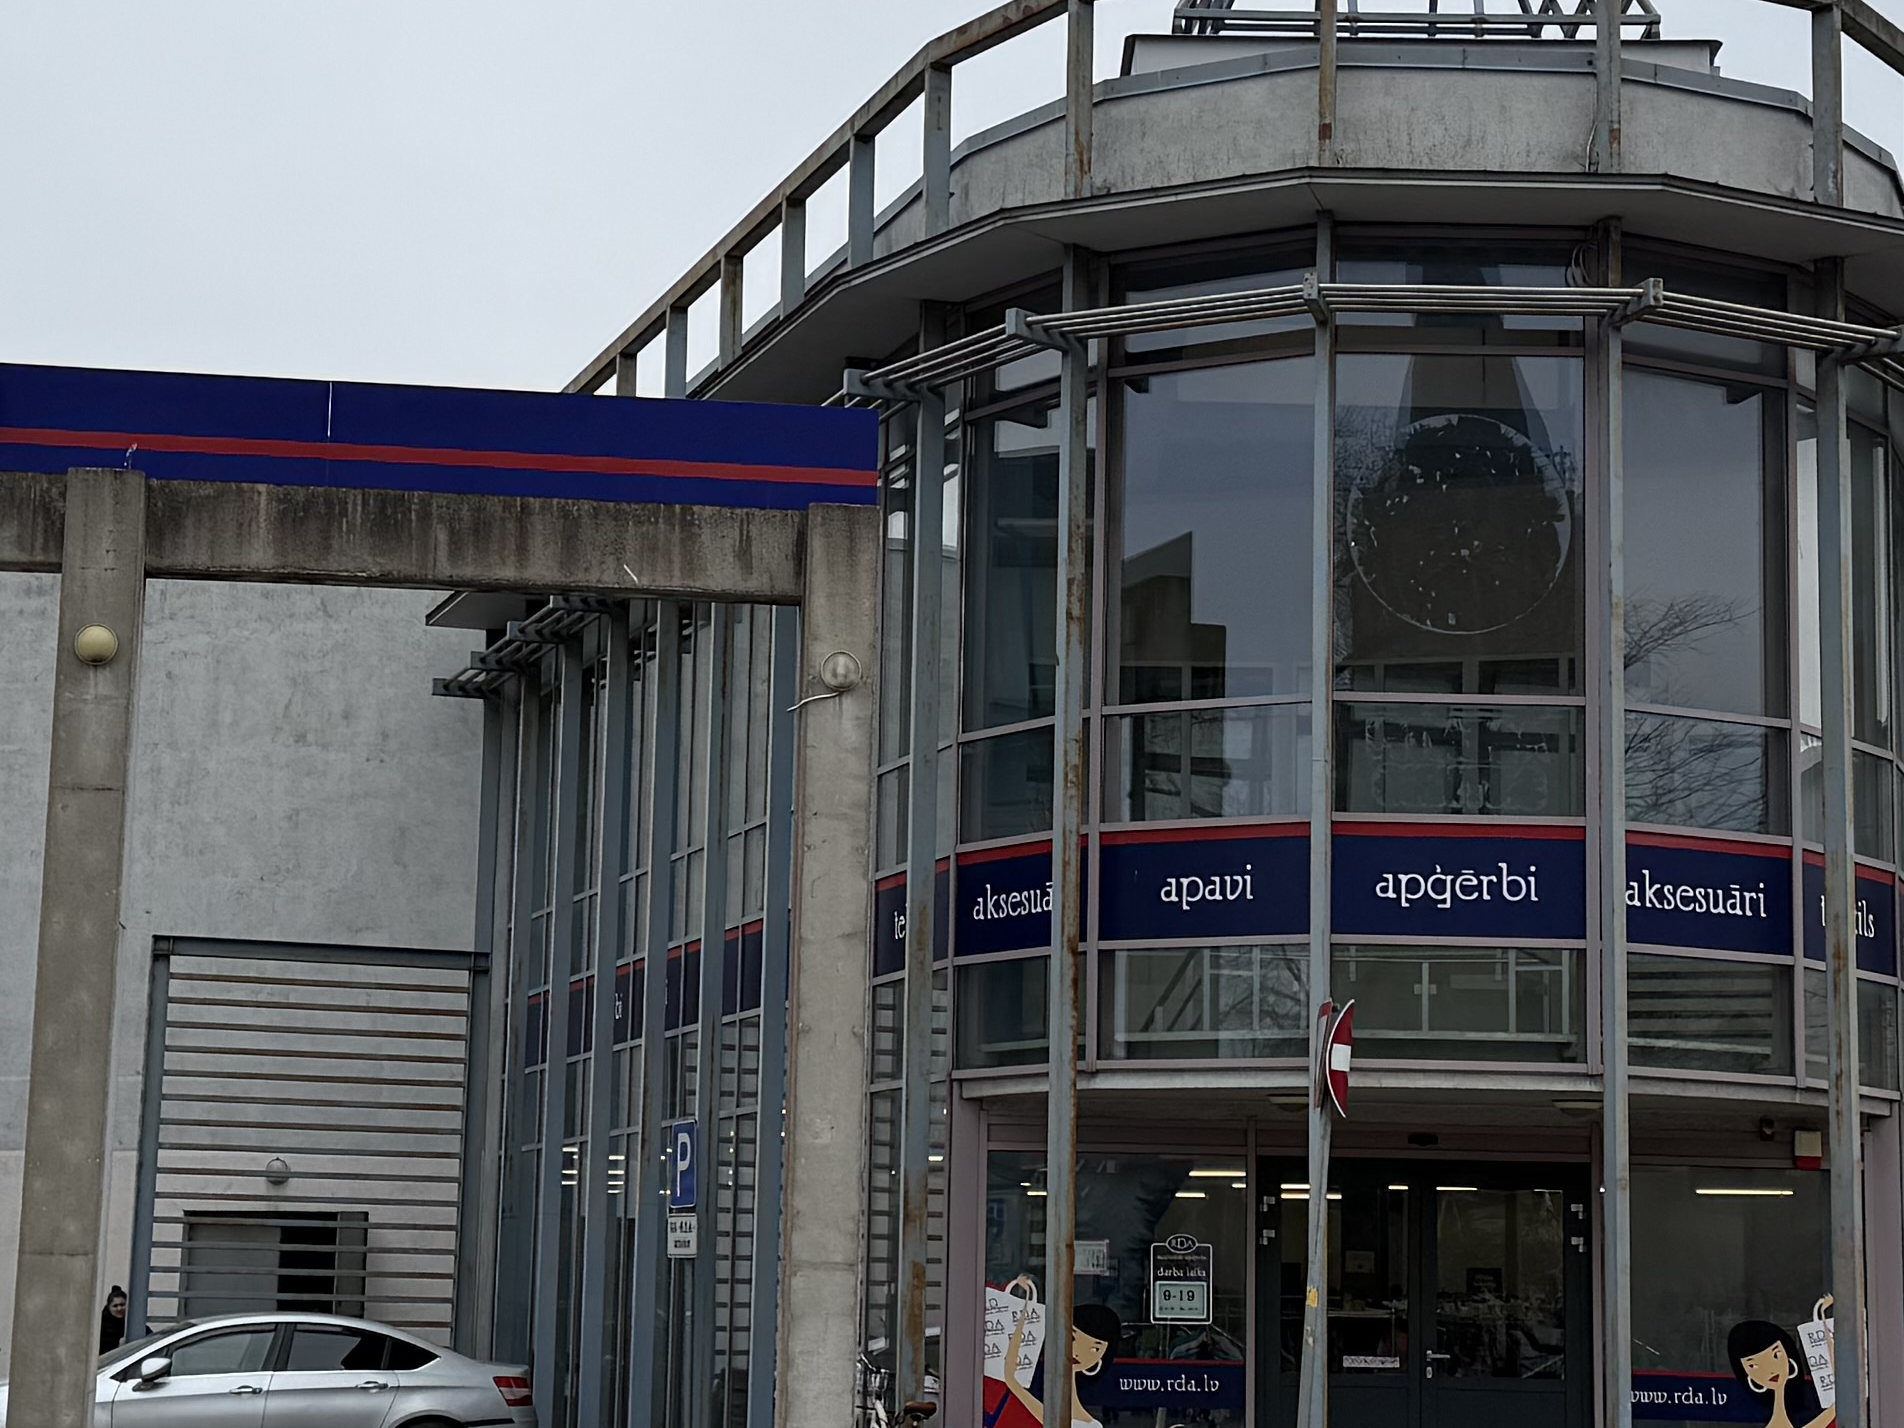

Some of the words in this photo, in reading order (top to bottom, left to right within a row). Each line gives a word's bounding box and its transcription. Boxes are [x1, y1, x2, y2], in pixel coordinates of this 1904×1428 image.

[972, 881, 1053, 921] aksesuā
[1159, 863, 1255, 911] apavi
[1374, 862, 1539, 909] apģērbi
[1625, 869, 1767, 918] aksesuāri
[1119, 1374, 1220, 1393] www.rda.lv
